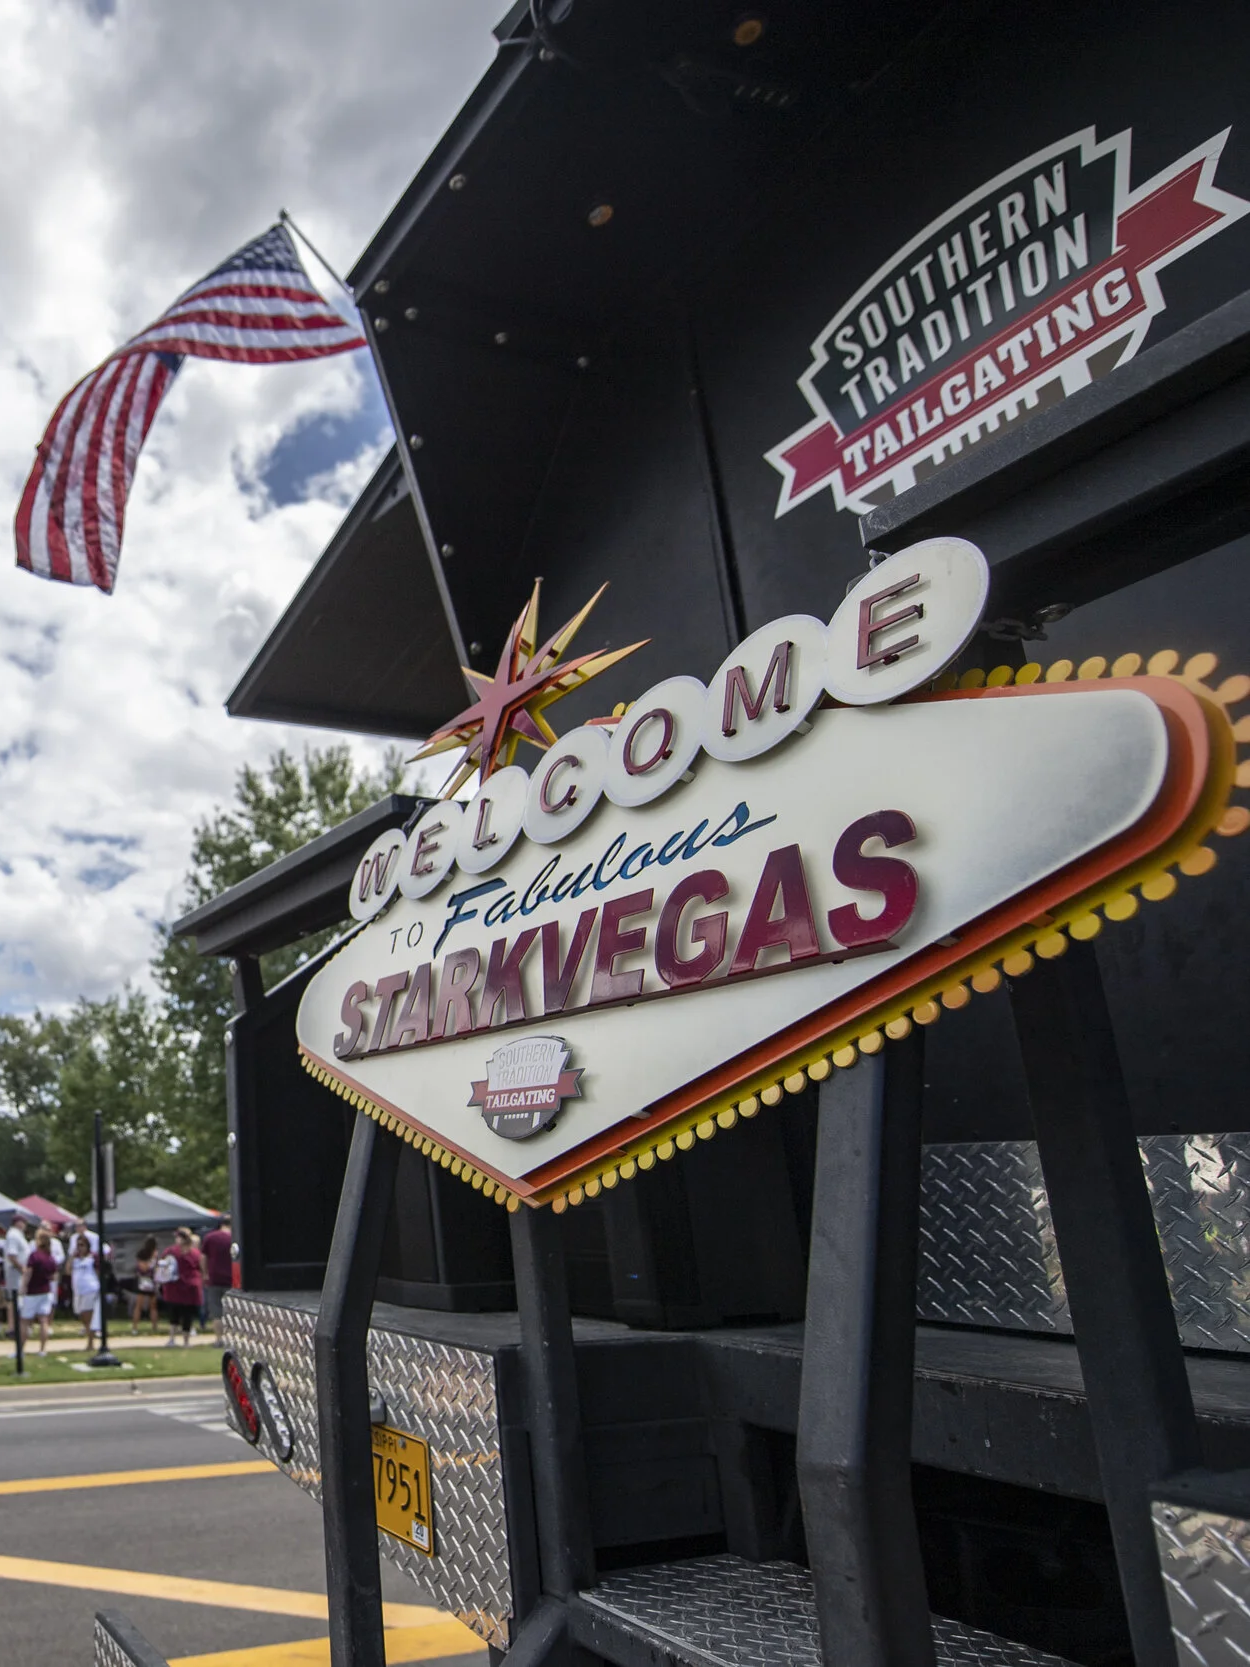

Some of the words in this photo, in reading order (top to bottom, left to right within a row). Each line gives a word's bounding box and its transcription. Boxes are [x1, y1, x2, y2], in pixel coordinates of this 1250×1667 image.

[834, 162, 1070, 370] SOUTHERN
[841, 213, 1090, 419] TRADITION
[842, 268, 1132, 477] TAILGATING
[357, 573, 924, 901] WELCOME
[333, 809, 919, 1060] STARKVEGAS
[390, 920, 422, 954] TO
[433, 802, 777, 957] Fabulous
[486, 1089, 556, 1108] TAILGATING
[496, 1065, 553, 1089] TRADITION
[498, 1044, 556, 1069] SOUTHERN
[373, 1453, 426, 1521] 7951
